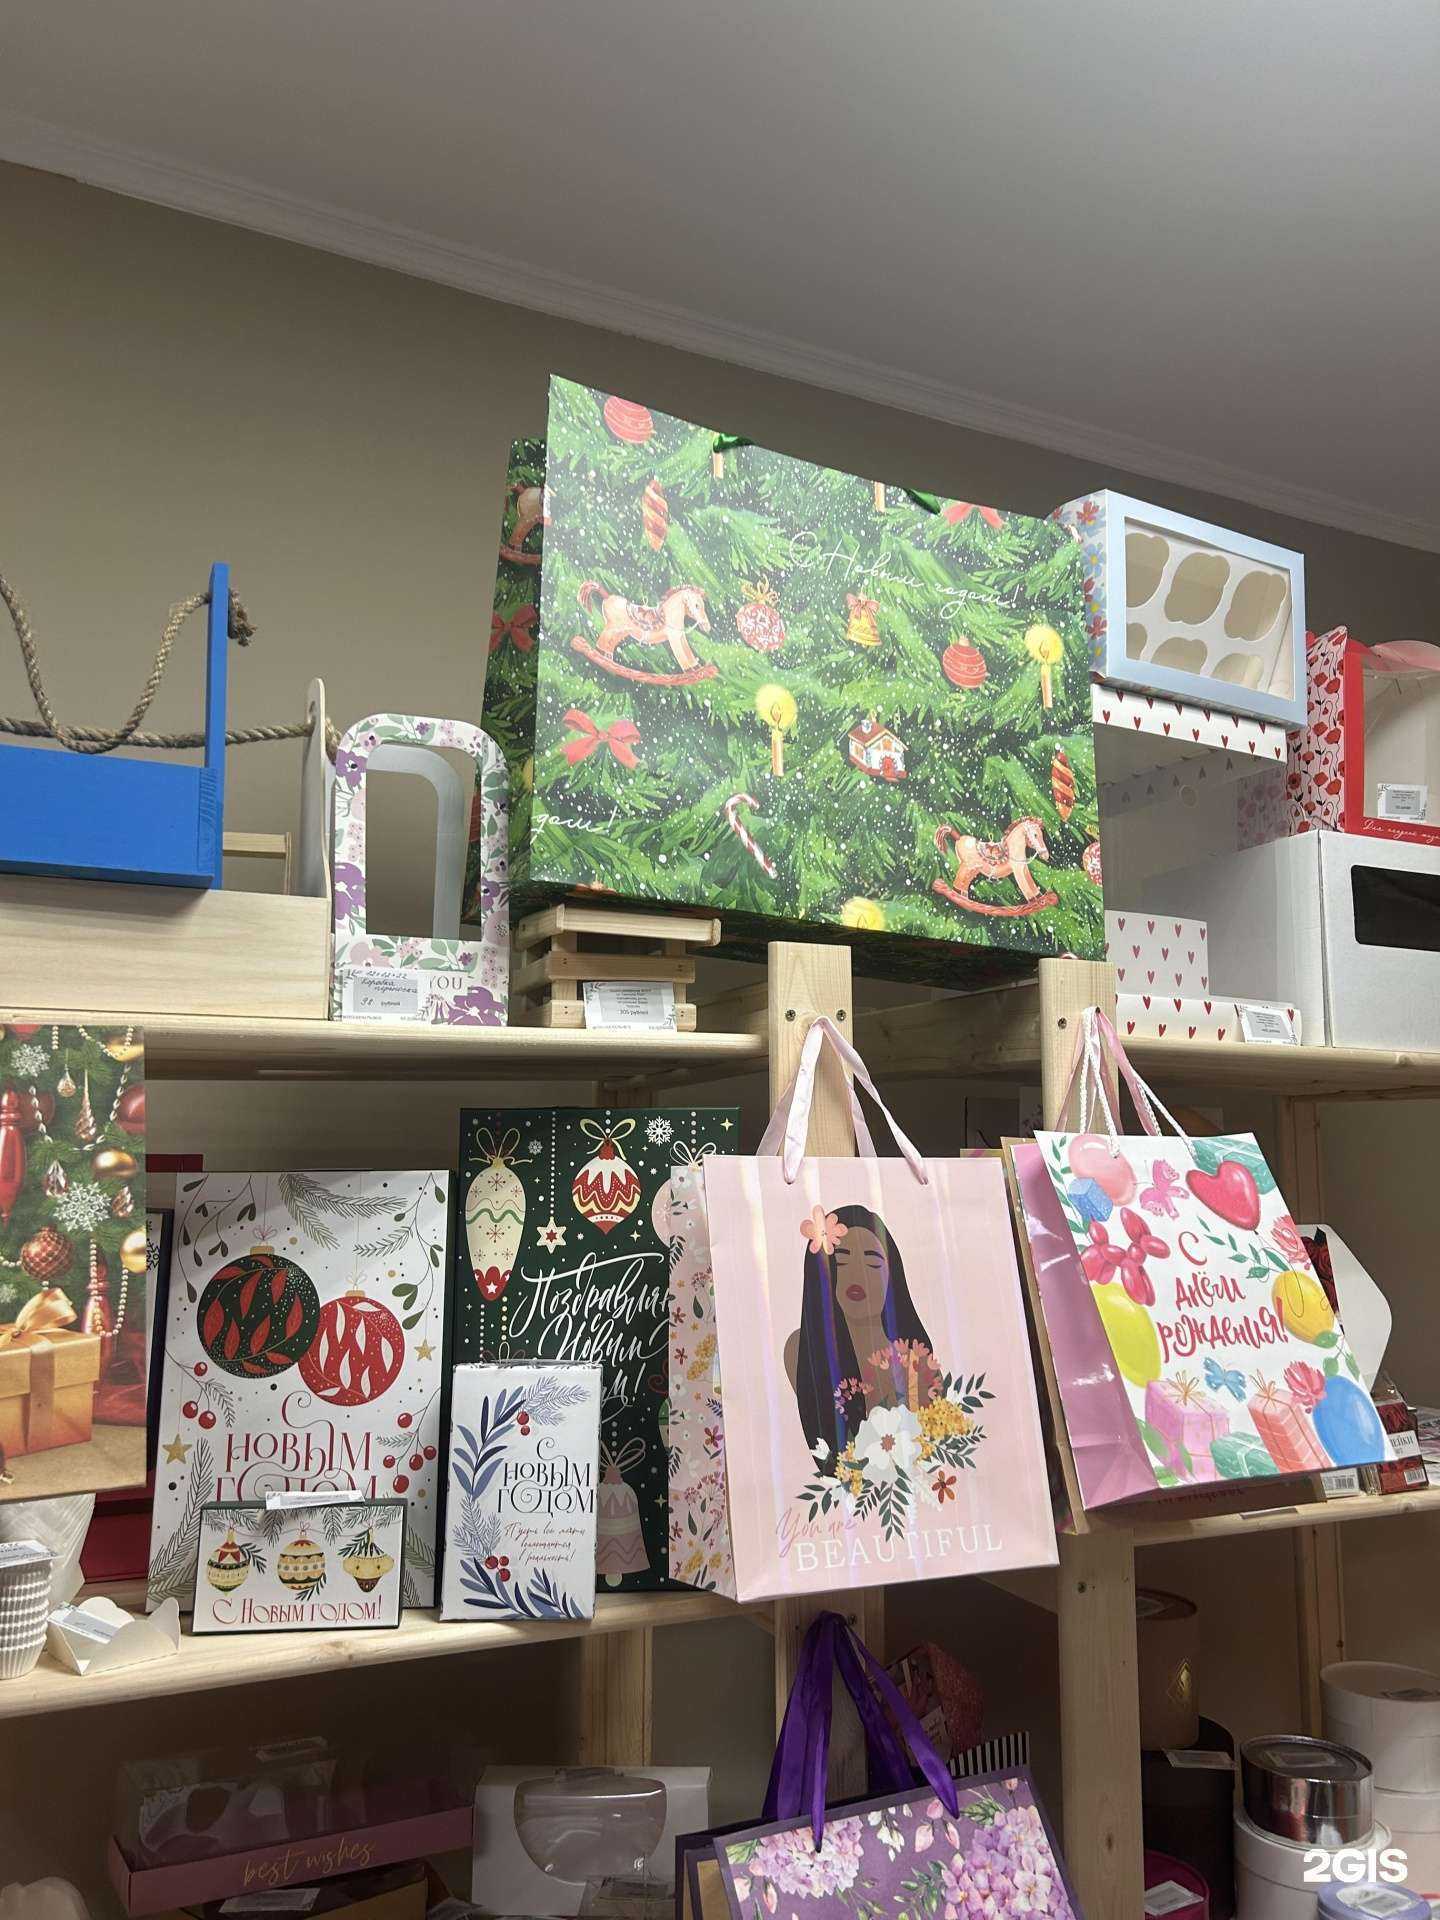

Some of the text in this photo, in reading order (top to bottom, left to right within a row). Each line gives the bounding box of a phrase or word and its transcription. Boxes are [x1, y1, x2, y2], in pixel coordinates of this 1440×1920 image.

[789, 531, 819, 567] С
[821, 538, 924, 588] Новым
[1178, 1231, 1208, 1266] С
[281, 1390, 313, 1429] С
[225, 1430, 372, 1473] НОВЫМ
[536, 1436, 556, 1461] С
[503, 1460, 591, 1491] НОВЫМ
[794, 1523, 1004, 1572] BEAUTIFUL
[212, 1598, 238, 1625] С
[243, 1837, 374, 1887] best wishes
